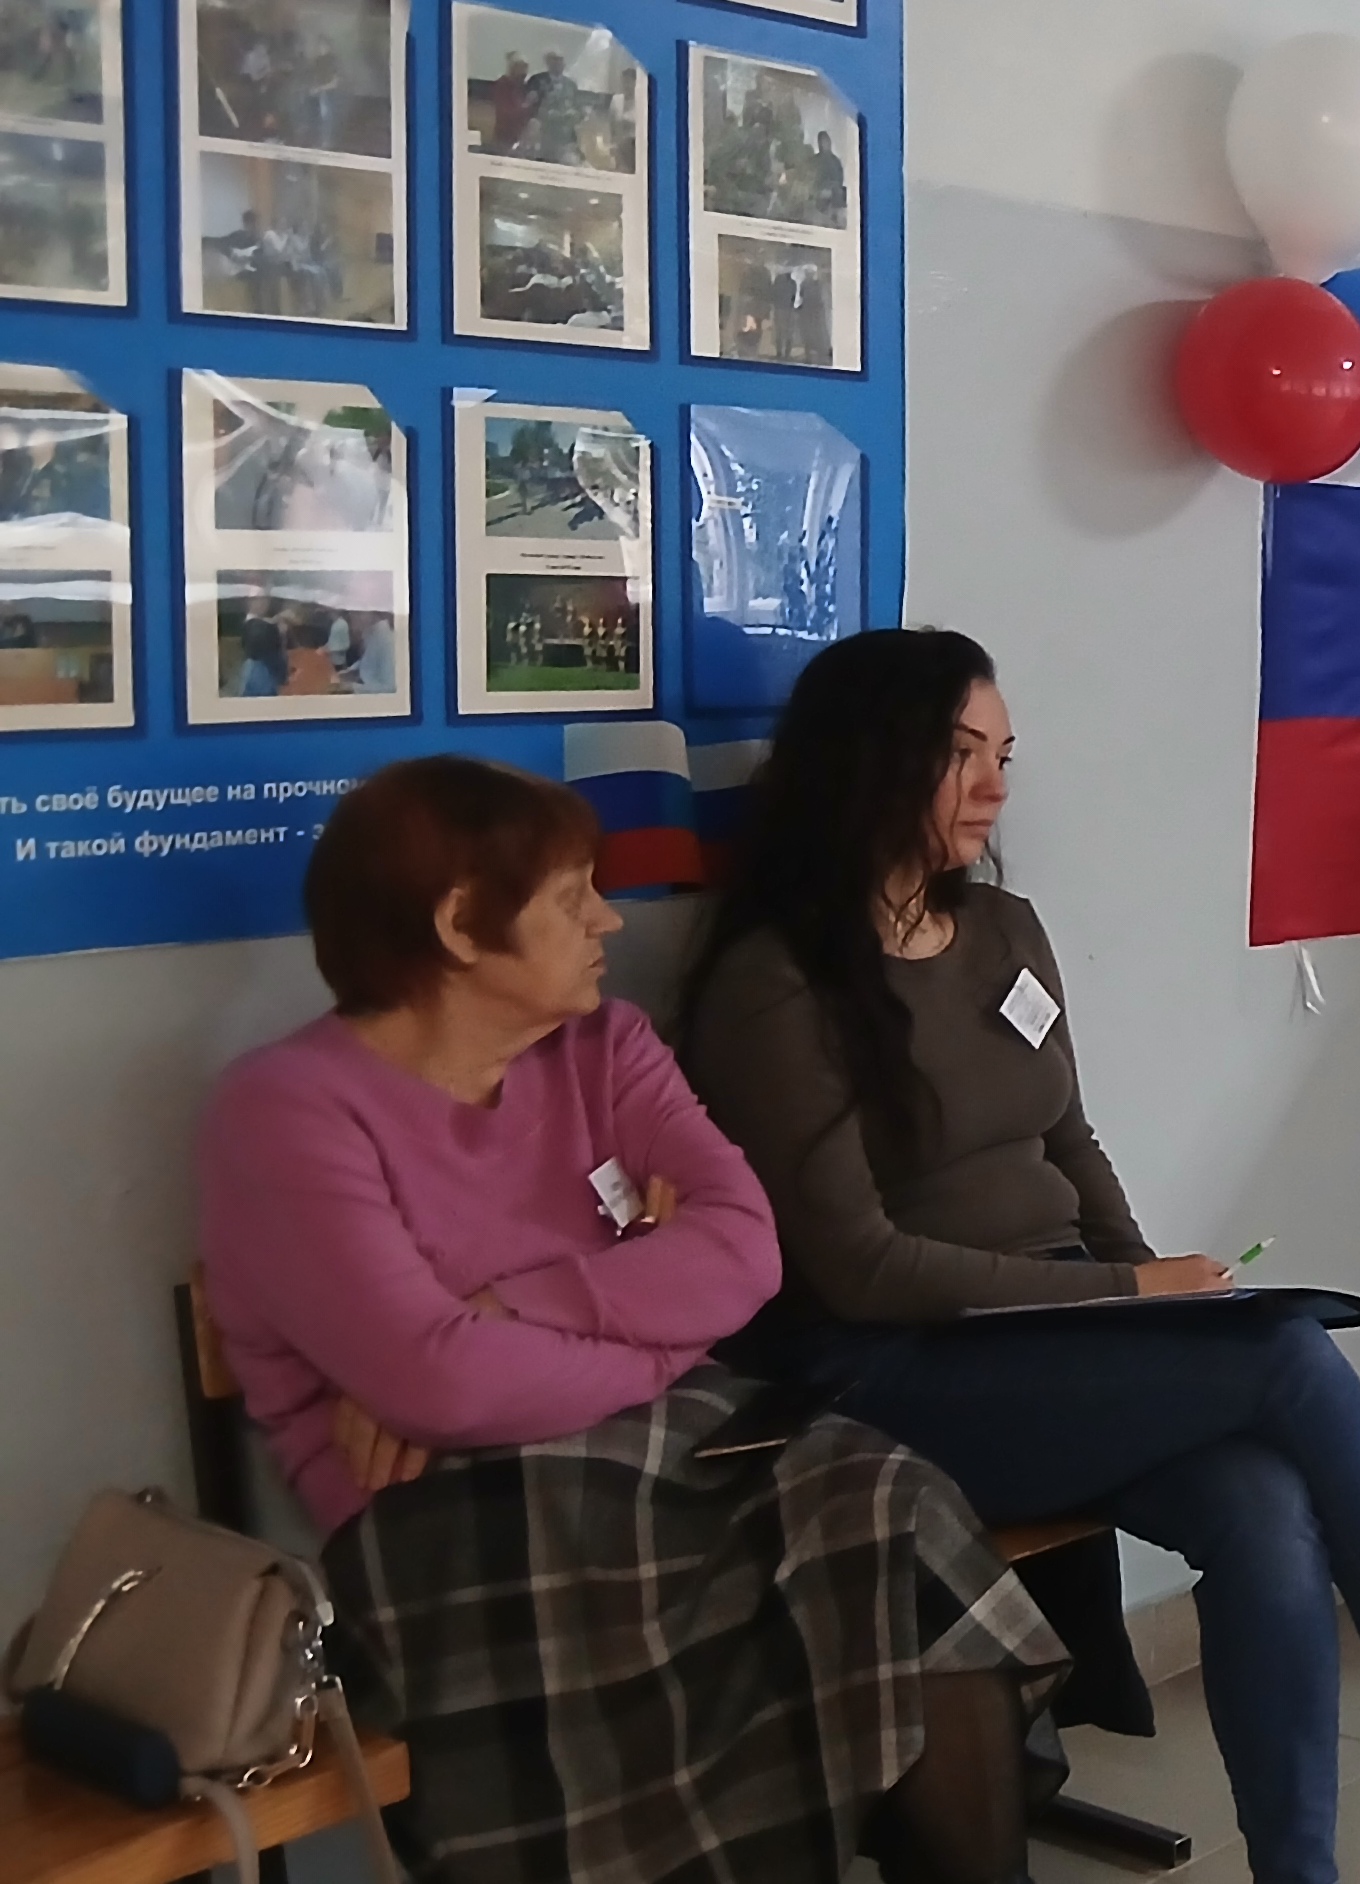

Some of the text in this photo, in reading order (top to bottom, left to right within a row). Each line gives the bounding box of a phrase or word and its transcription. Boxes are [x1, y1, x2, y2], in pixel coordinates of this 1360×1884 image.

[35, 787, 99, 812] своё
[107, 784, 219, 813] будущее
[227, 783, 256, 801] на
[16, 840, 36, 861] И
[46, 832, 126, 859] такой
[134, 824, 288, 858] фундамент
